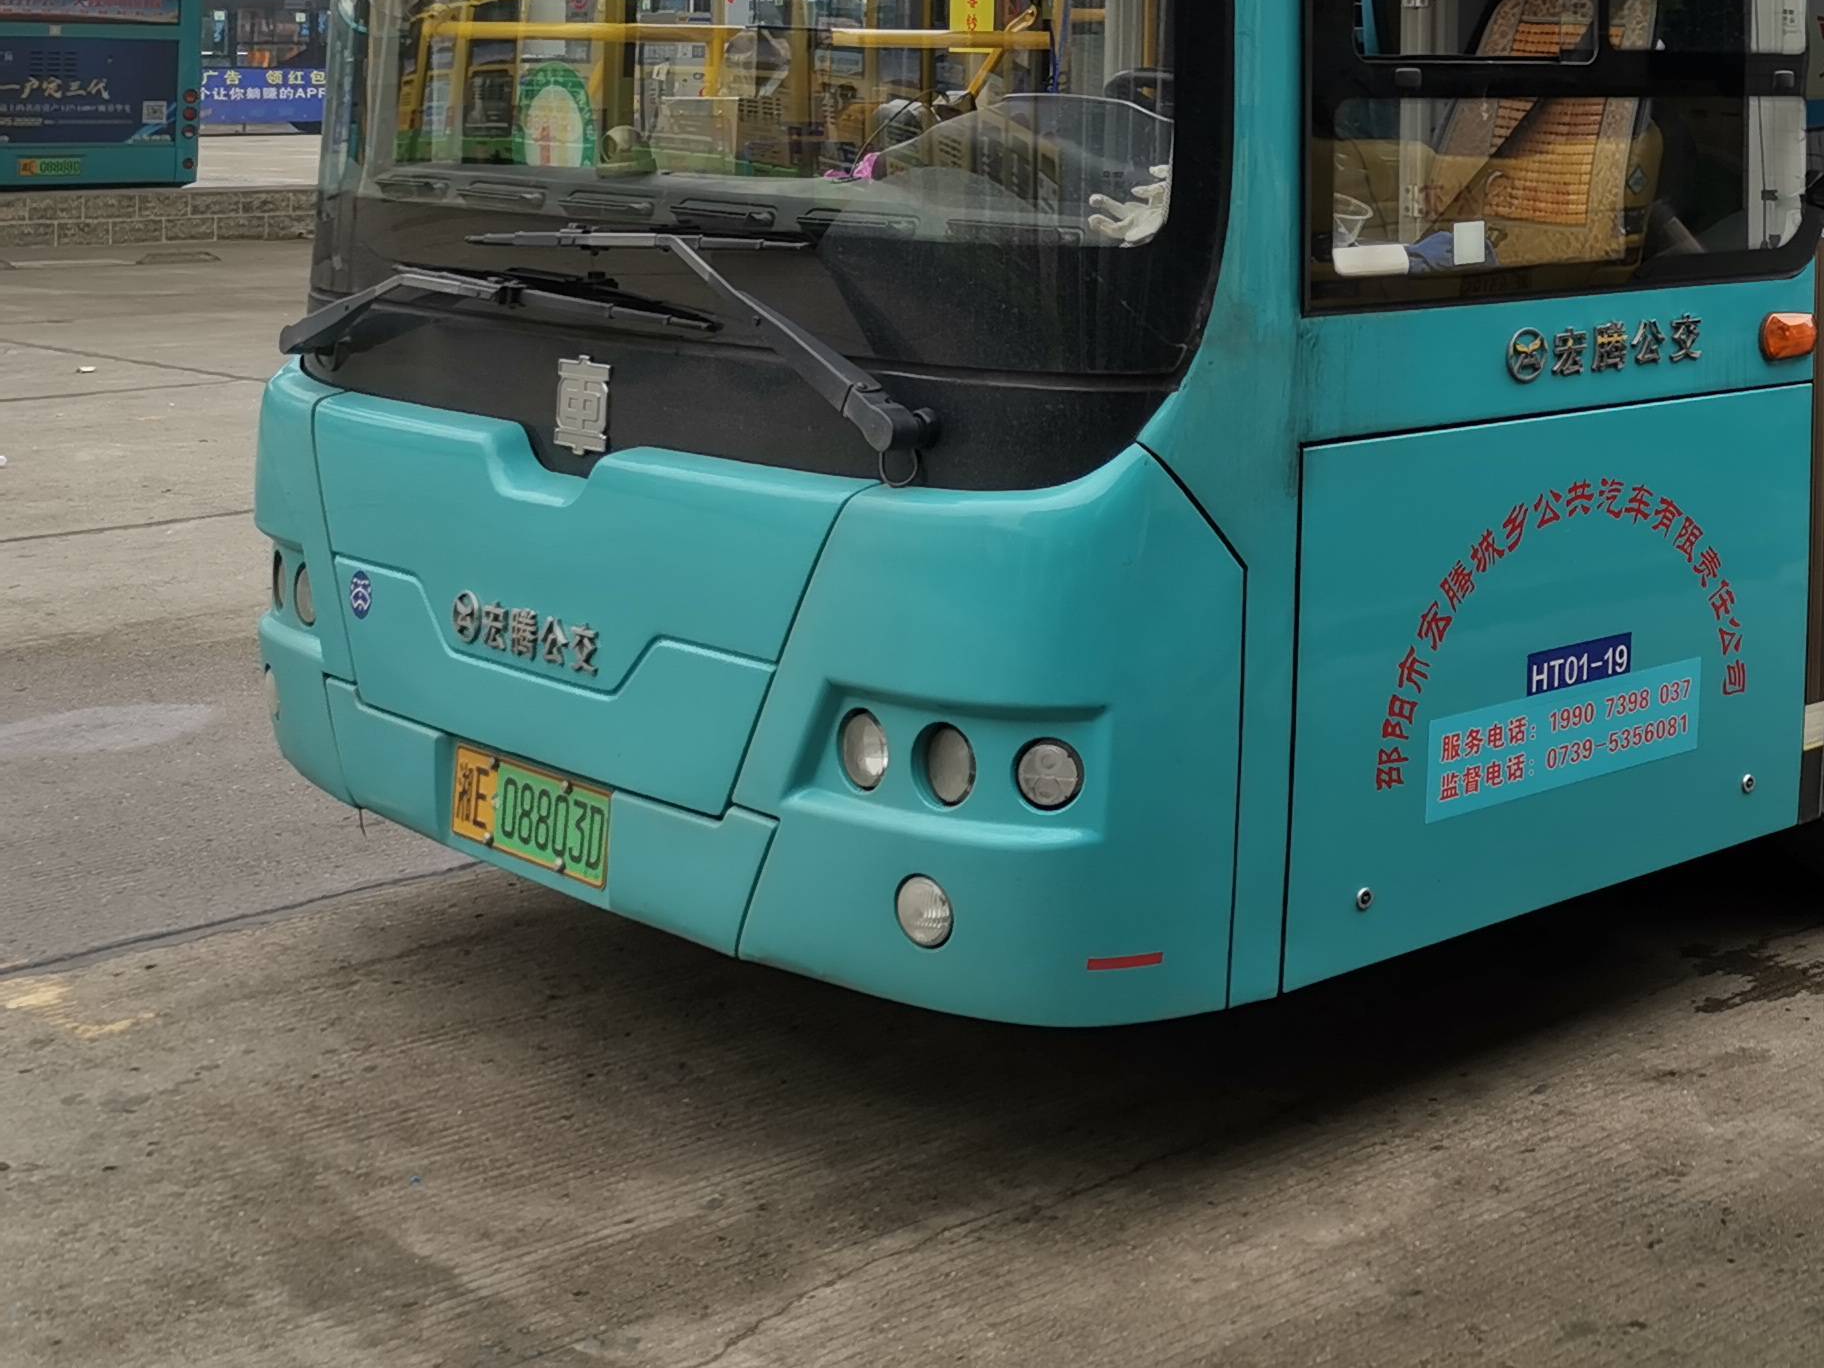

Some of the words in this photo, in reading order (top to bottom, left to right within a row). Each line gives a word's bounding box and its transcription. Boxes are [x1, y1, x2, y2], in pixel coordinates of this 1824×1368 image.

[1553, 313, 1702, 376] 宏腾公交
[482, 602, 600, 677] 宏腾公交
[1532, 645, 1628, 693] HT01-19
[1550, 702, 1595, 732] 1990
[1606, 689, 1650, 719] 7398
[1659, 679, 1692, 705] 037
[1546, 714, 1689, 770] 0739-5356081
